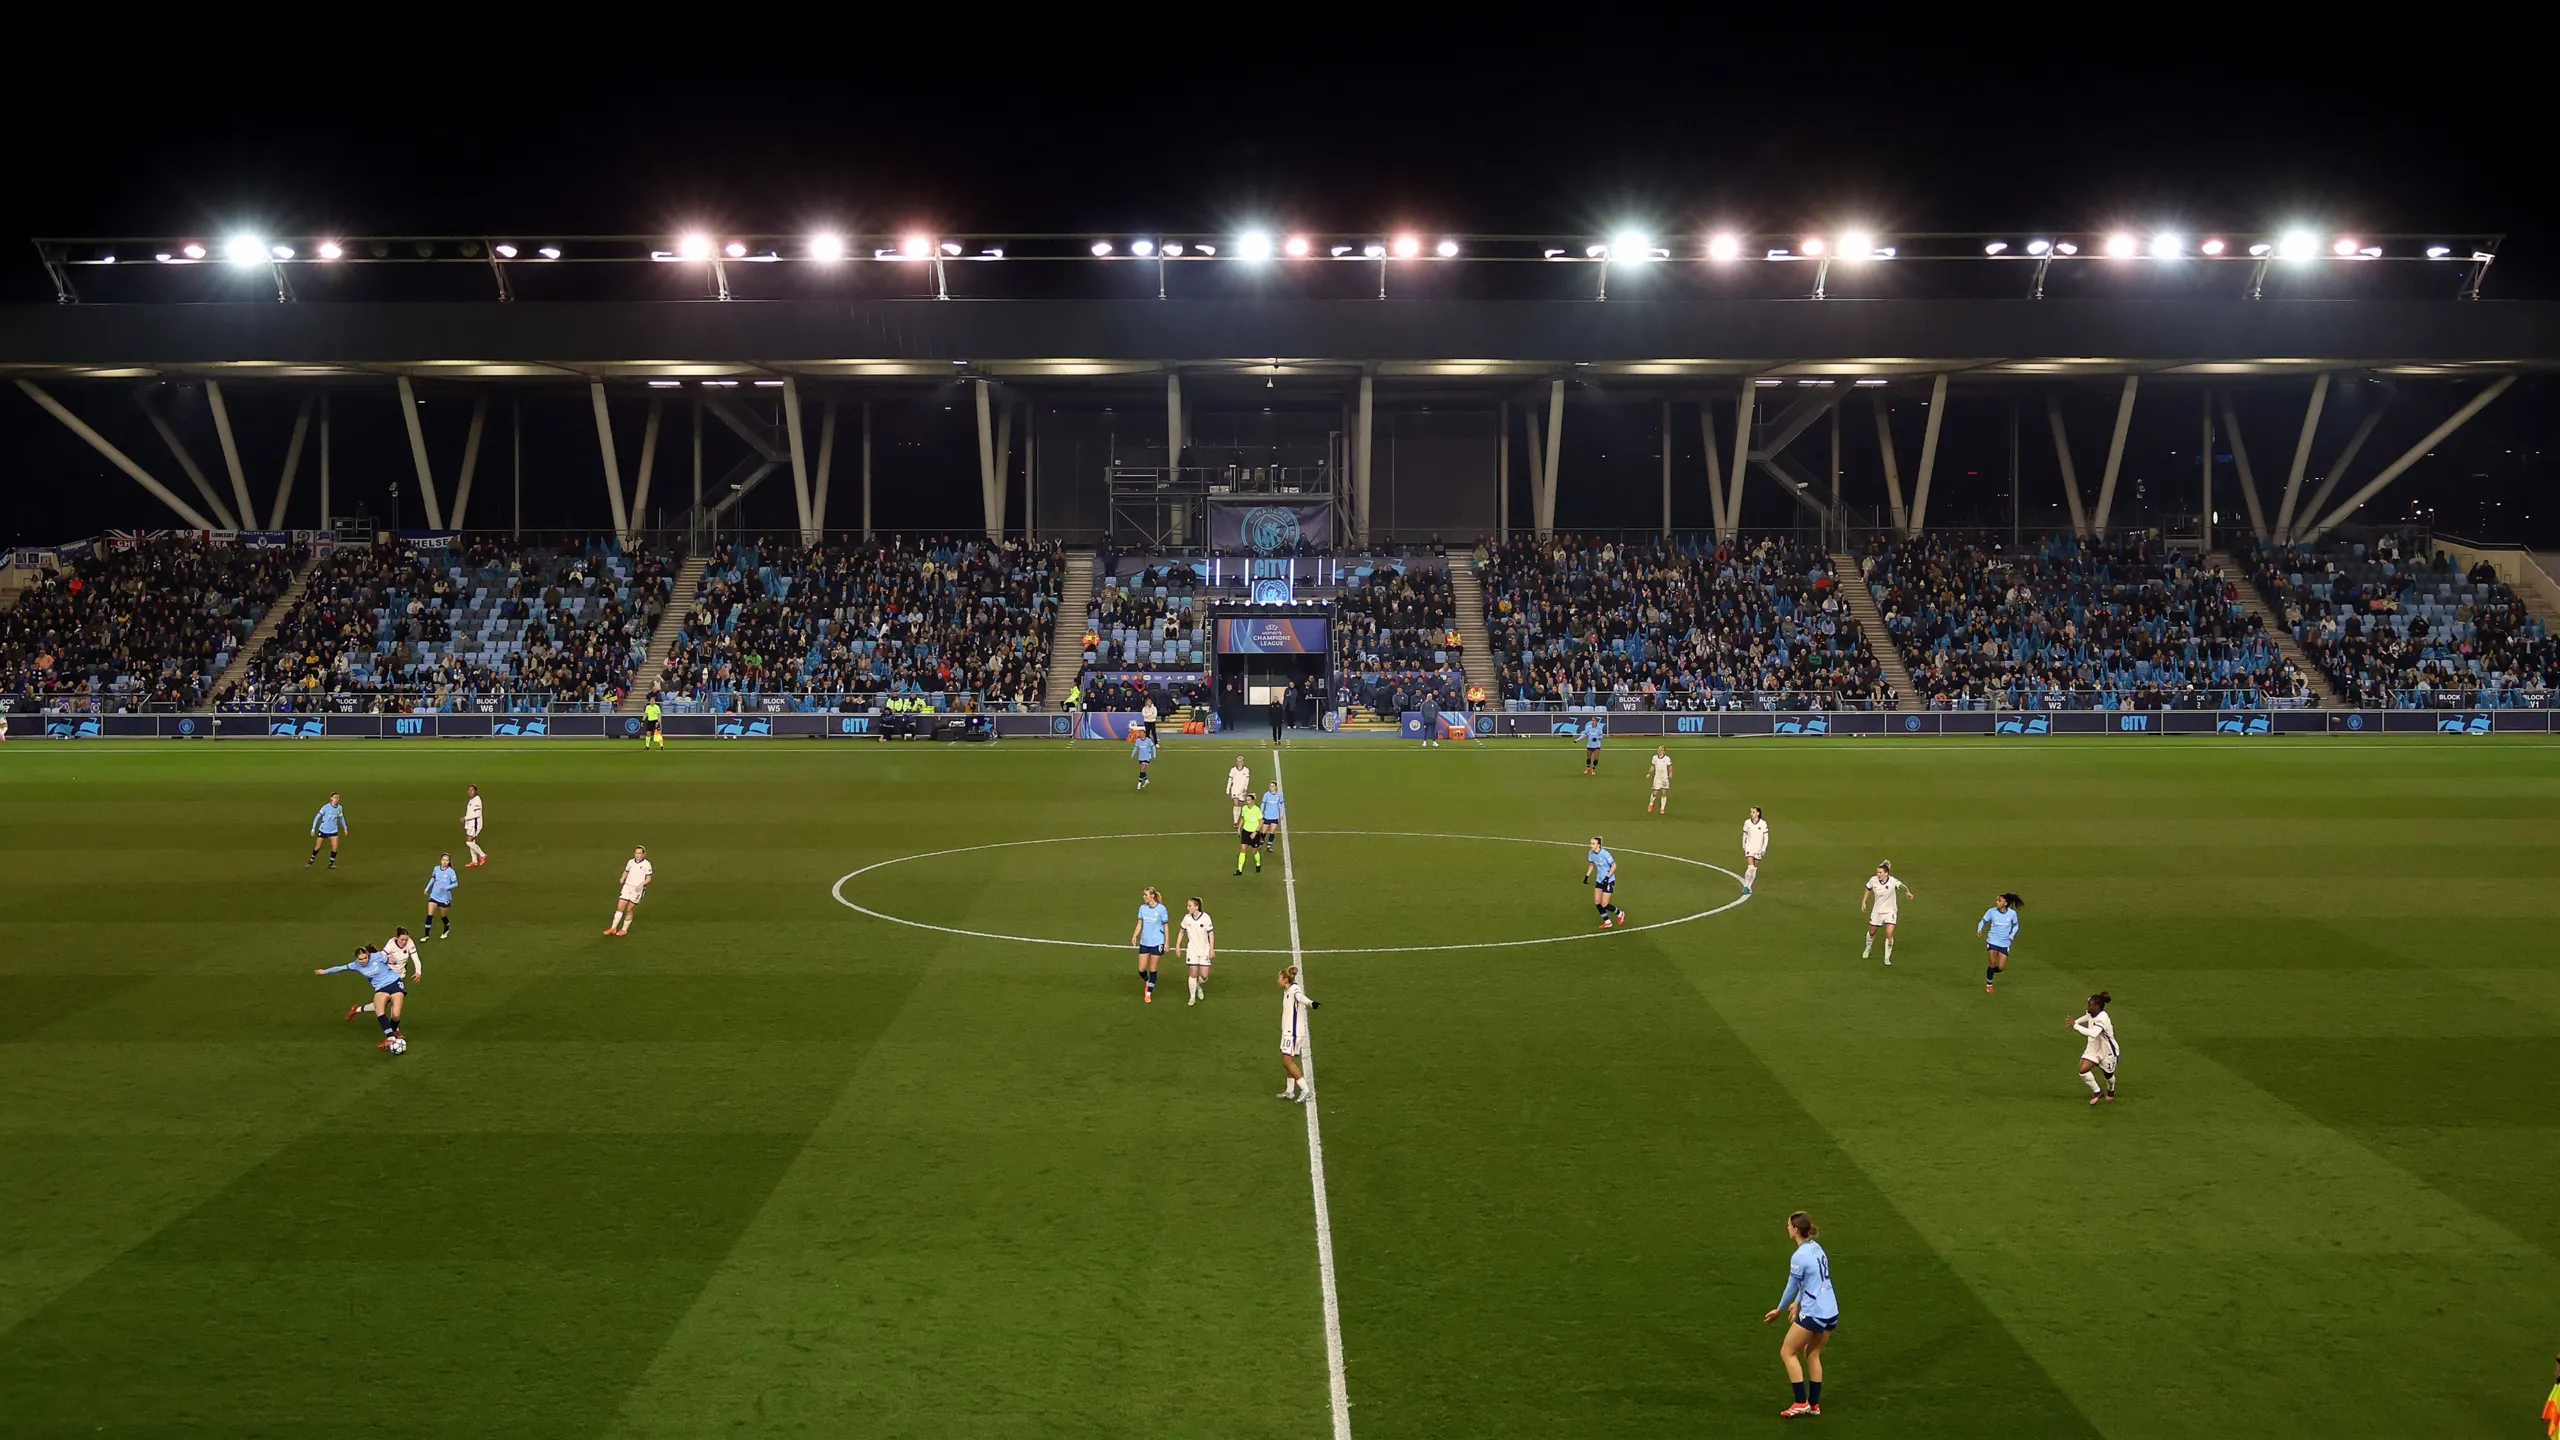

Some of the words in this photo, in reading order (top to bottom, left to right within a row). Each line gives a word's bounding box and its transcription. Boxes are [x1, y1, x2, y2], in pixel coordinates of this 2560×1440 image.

[1255, 508, 1296, 536] MANCHESTER
[414, 539, 449, 547] HELSE
[1254, 559, 1288, 578] CITY
[480, 704, 494, 712] W6
[767, 704, 781, 712] W5
[396, 718, 423, 734] CITY
[842, 718, 869, 733] CITY
[1677, 716, 1705, 732] CITY
[2120, 716, 2148, 731] CITY
